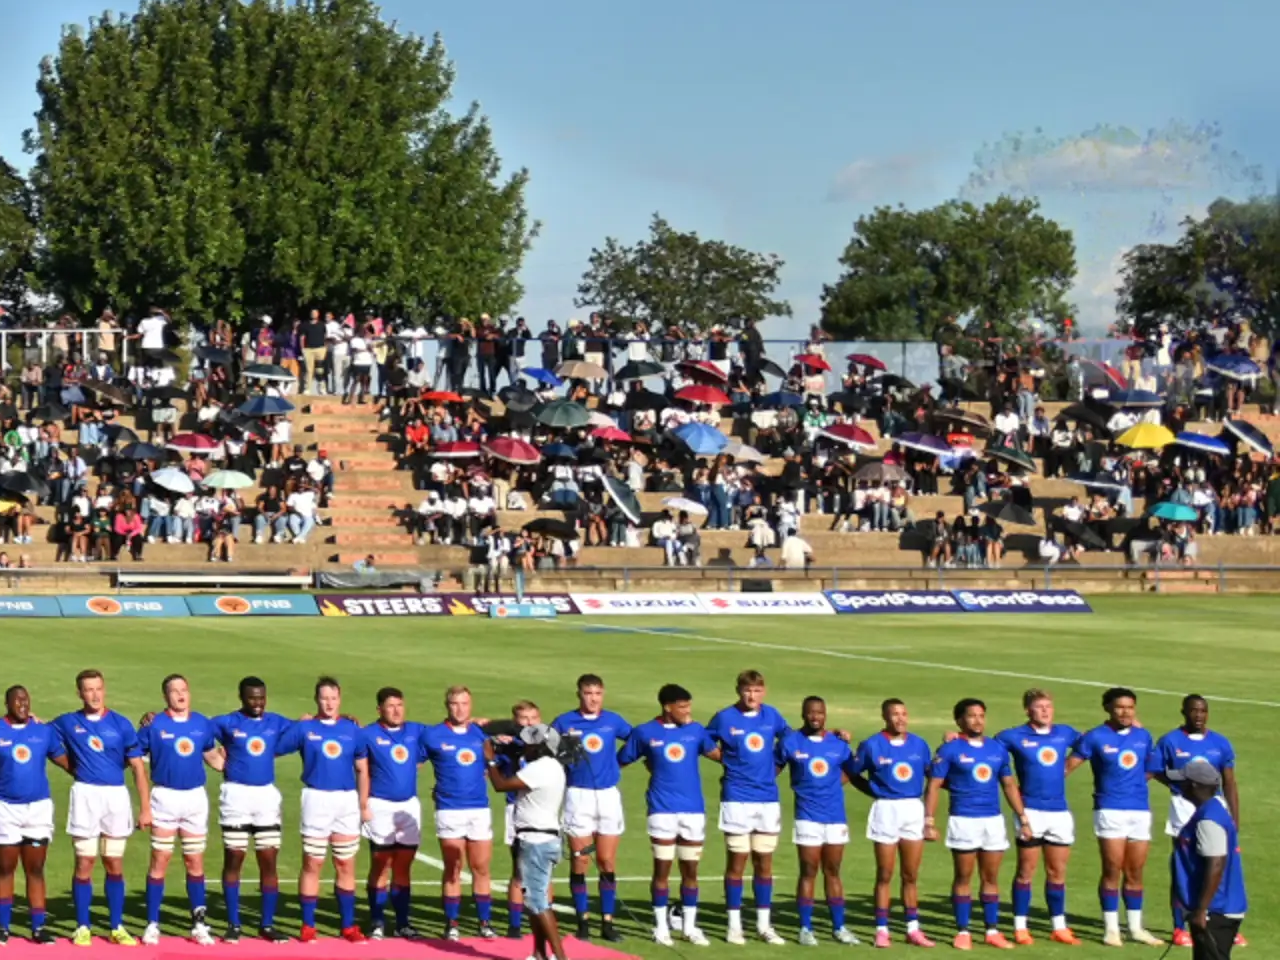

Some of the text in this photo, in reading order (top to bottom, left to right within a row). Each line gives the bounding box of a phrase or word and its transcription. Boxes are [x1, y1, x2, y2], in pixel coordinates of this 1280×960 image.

[252, 599, 291, 609] FNB
[609, 599, 696, 608] SUZUKI
[735, 599, 824, 608] SUZUKI
[831, 592, 956, 608] SportPesa
[959, 591, 1084, 608] SportPesa
[124, 601, 162, 611] FNB
[343, 597, 442, 614] STEERS
